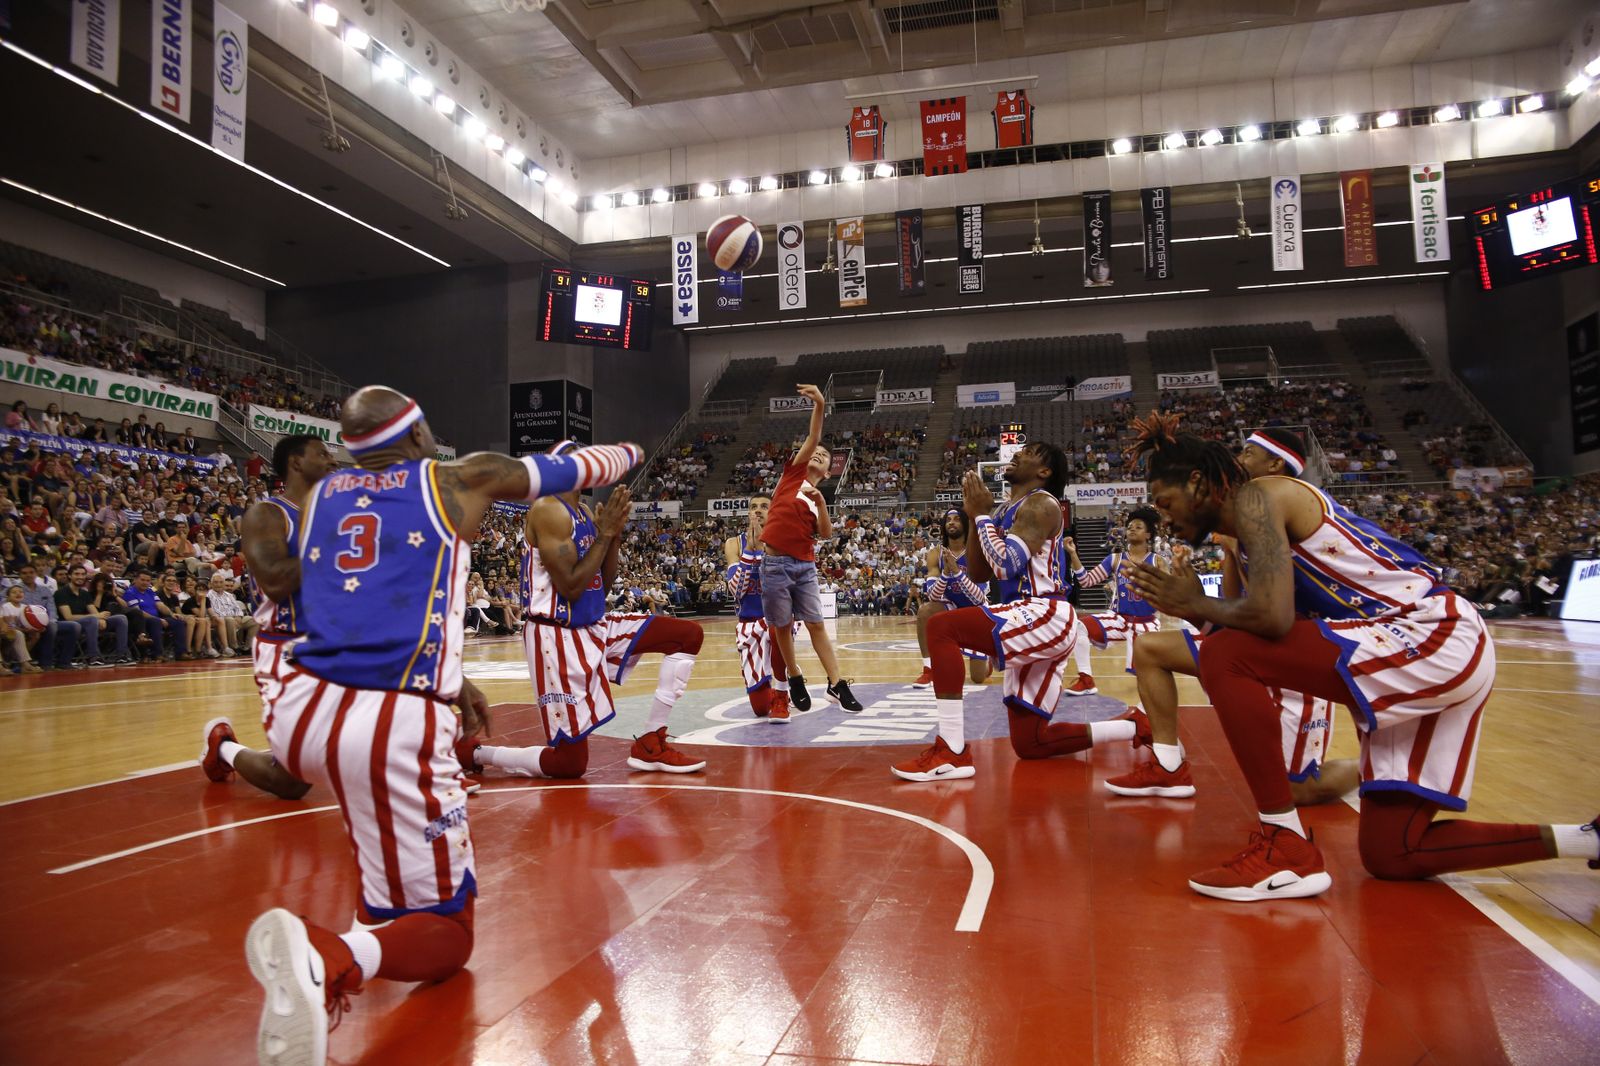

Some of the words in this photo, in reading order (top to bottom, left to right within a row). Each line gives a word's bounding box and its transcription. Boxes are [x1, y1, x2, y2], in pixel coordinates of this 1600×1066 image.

[926, 110, 961, 124] CAMPEÓN
[1010, 104, 1016, 113] 8
[863, 119, 871, 128] 18
[963, 206, 971, 216] DE
[1420, 188, 1439, 259] fertisac
[1481, 212, 1498, 225] 91
[963, 216, 972, 249] VERDAD
[972, 206, 982, 260] BURGERS
[1283, 203, 1297, 252] Cuerva
[1361, 202, 1374, 262] ANTONIO
[1155, 210, 1168, 279] interiorismo
[557, 276, 569, 286] 91
[677, 241, 693, 300] asisa
[785, 253, 803, 306] otero
[843, 260, 866, 299] enPie
[637, 286, 648, 296] 58
[1162, 374, 1212, 387] IDEAL
[108, 382, 213, 419] COVIRAN
[880, 391, 928, 402] IDEAL
[253, 414, 330, 443] COVIRAN
[1001, 433, 1018, 445] 24
[1077, 489, 1105, 497] RADIO
[1116, 487, 1145, 496] MARCA
[336, 512, 381, 573] 3
